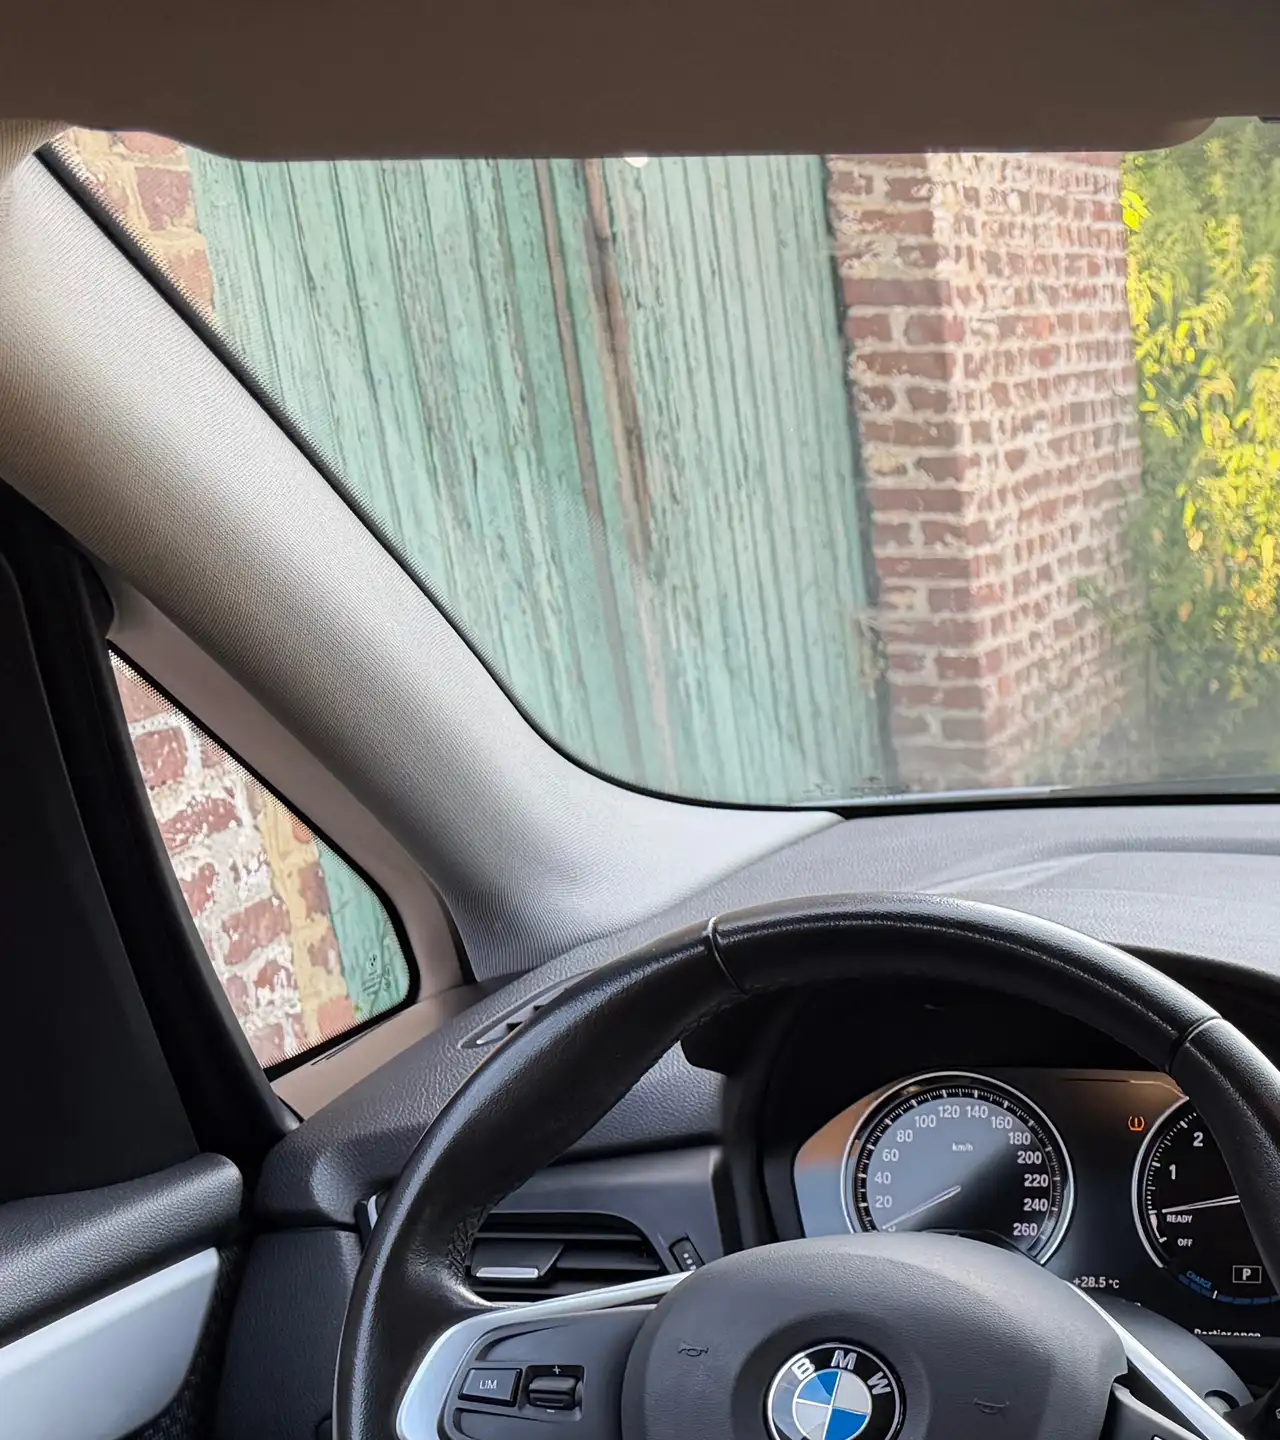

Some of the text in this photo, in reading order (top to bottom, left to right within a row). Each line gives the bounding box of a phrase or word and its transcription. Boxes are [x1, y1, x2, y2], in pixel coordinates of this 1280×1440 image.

[938, 1105, 960, 1118] 120
[966, 1105, 988, 1118] 140
[914, 1115, 937, 1128] 100
[991, 1116, 1013, 1129] 160
[896, 1130, 913, 1142] 80
[1008, 1132, 1031, 1146] 180
[1192, 1131, 1204, 1147] 2
[952, 1142, 974, 1152] km/h
[882, 1149, 899, 1162] 60
[1017, 1151, 1042, 1165] 200
[1168, 1163, 1177, 1180] 1
[874, 1172, 892, 1185] 40
[1023, 1173, 1049, 1187] 220
[875, 1195, 893, 1208] 20
[1023, 1198, 1049, 1212] 240
[1166, 1214, 1193, 1224] READY
[1012, 1222, 1038, 1236] 260
[1177, 1238, 1193, 1247] OFF
[1242, 1268, 1252, 1281] P
[1072, 1275, 1107, 1289] +28.5
[790, 1349, 893, 1396] BMW
[479, 1379, 497, 1390] LIM
